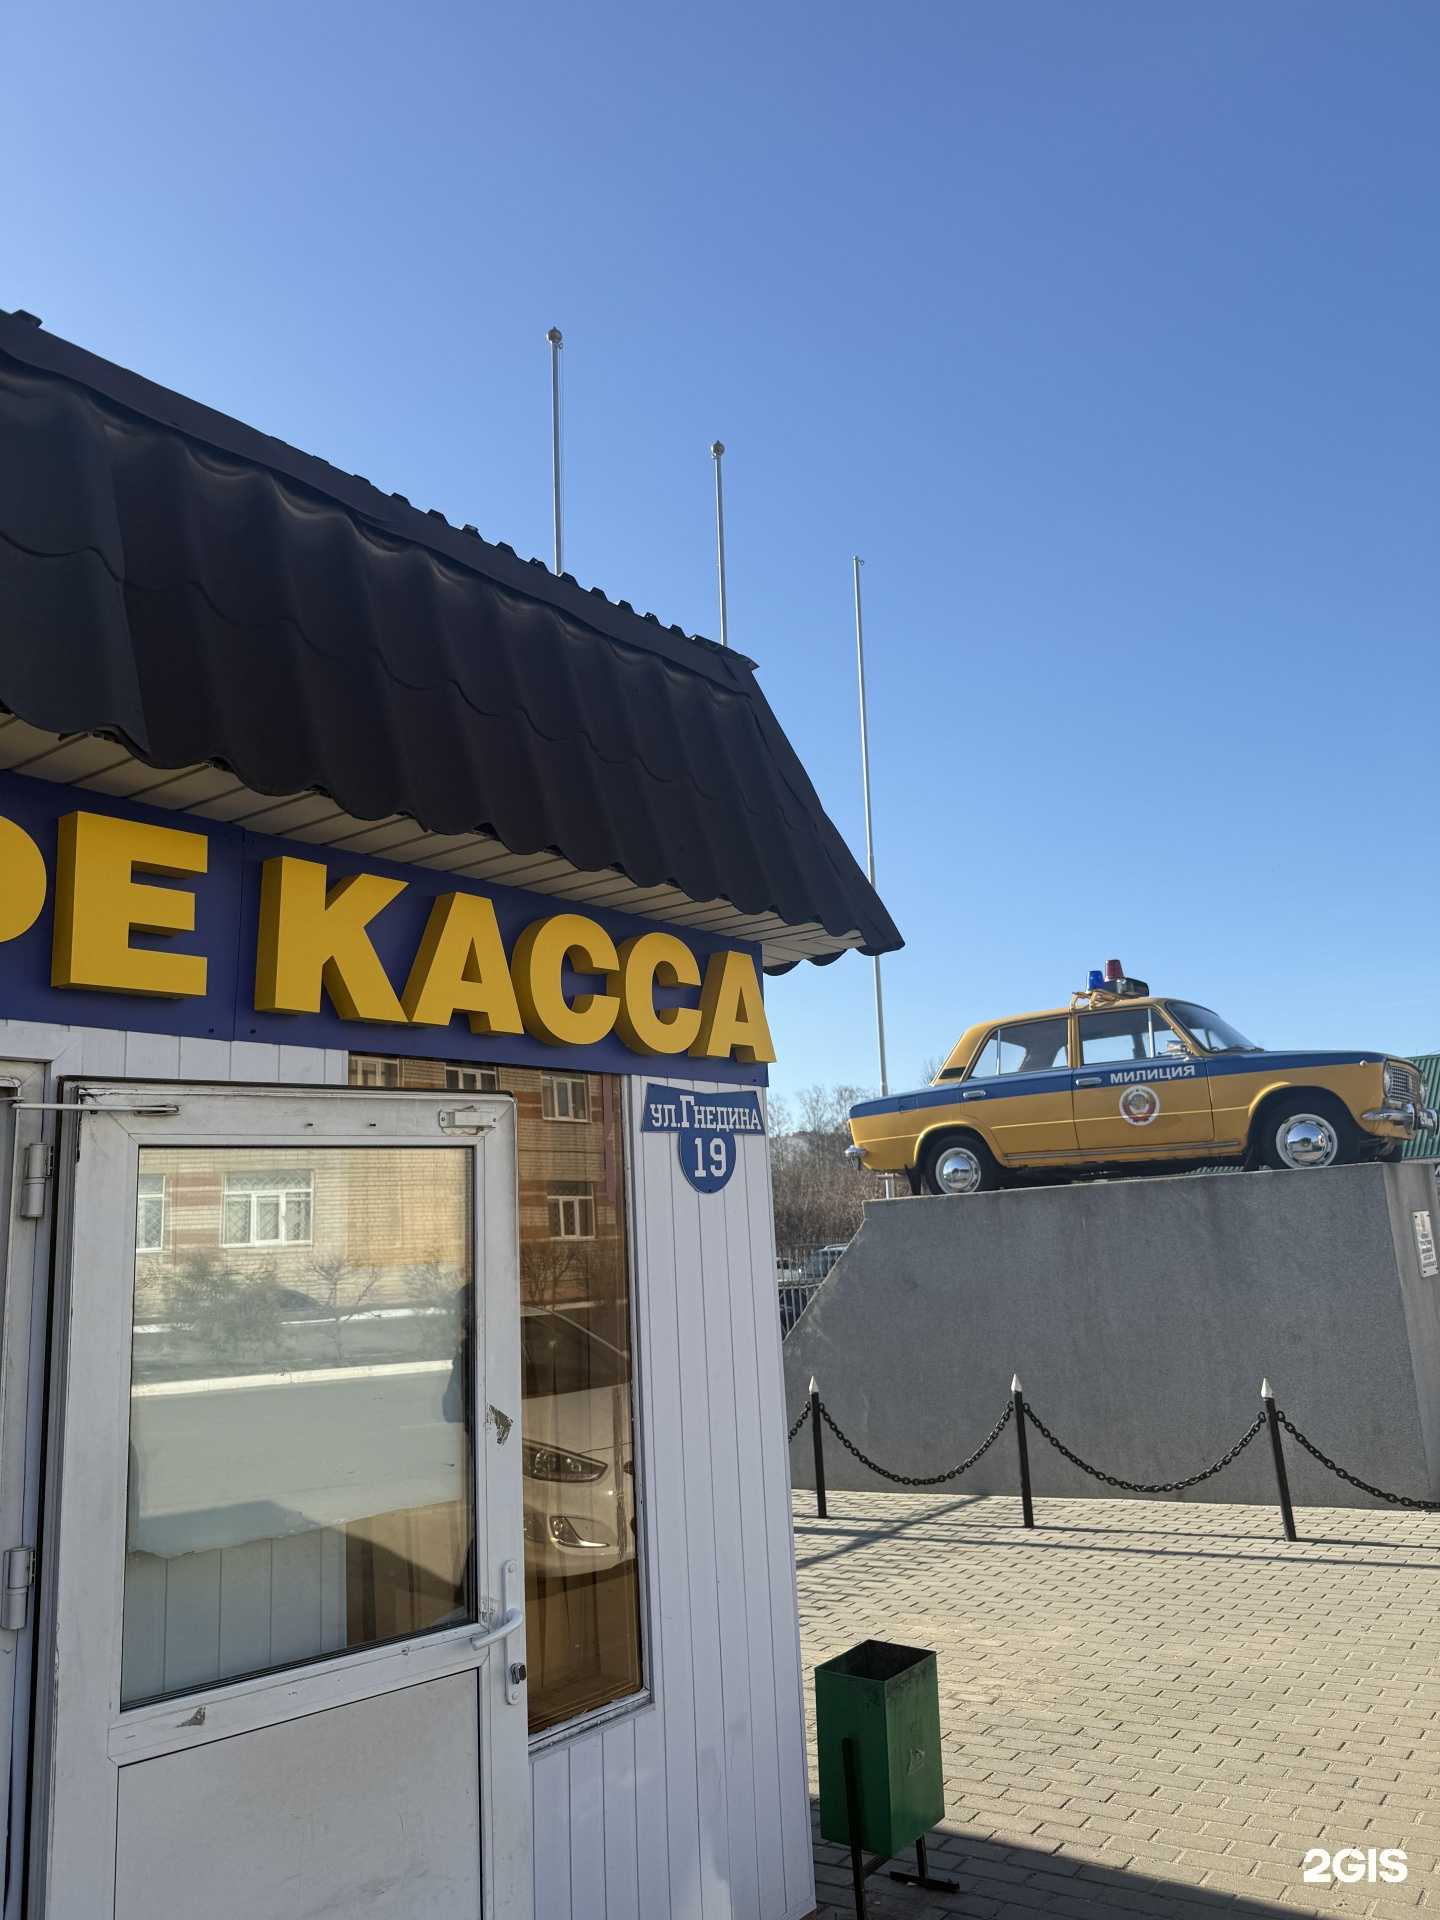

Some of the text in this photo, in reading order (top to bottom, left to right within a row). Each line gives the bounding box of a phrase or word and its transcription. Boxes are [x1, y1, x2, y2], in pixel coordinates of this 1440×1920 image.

[254, 855, 777, 1063] КАССА
[1110, 1065, 1195, 1084] МИЛИЦИЯ
[694, 1137, 727, 1177] 19
